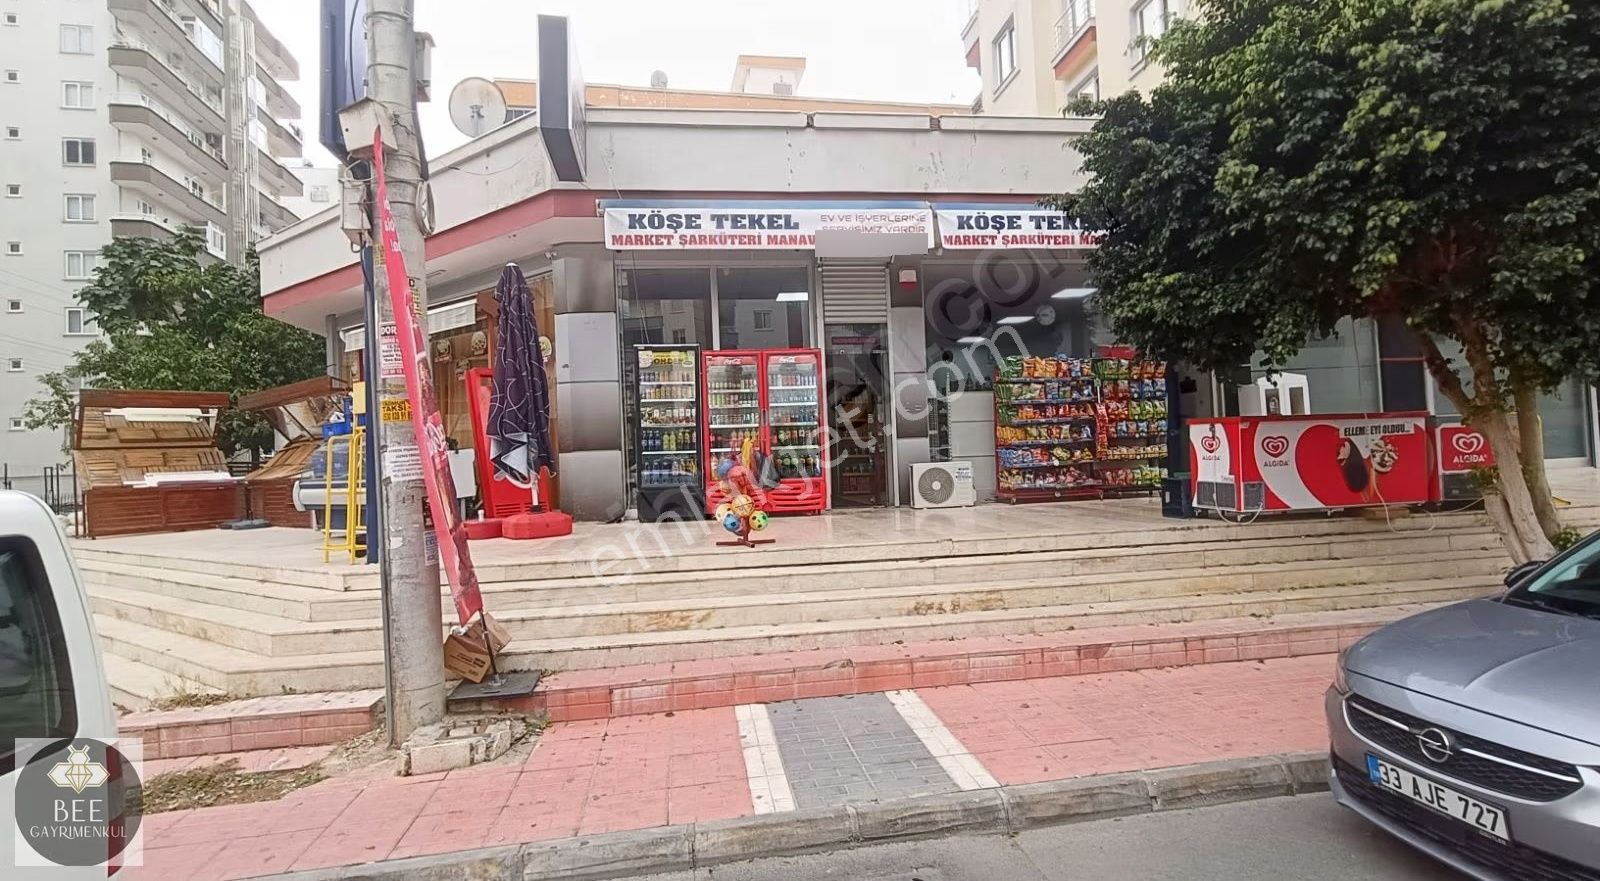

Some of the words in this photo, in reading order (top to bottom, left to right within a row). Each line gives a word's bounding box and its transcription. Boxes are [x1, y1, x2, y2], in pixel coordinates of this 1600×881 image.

[628, 210, 701, 233] KÖŞE
[711, 214, 799, 229] TEKEL
[821, 214, 834, 222] EV
[838, 214, 850, 222] VE
[957, 211, 1021, 233] KÖŞE
[611, 235, 674, 246] MARKET
[678, 232, 762, 249] ŞARKÜTERİ
[944, 235, 998, 245] MARKET
[1001, 232, 1075, 248] ŞARKÜTERİ
[1379, 763, 1402, 790] 33
[1412, 776, 1448, 811] AJE
[1457, 795, 1499, 832] 727
